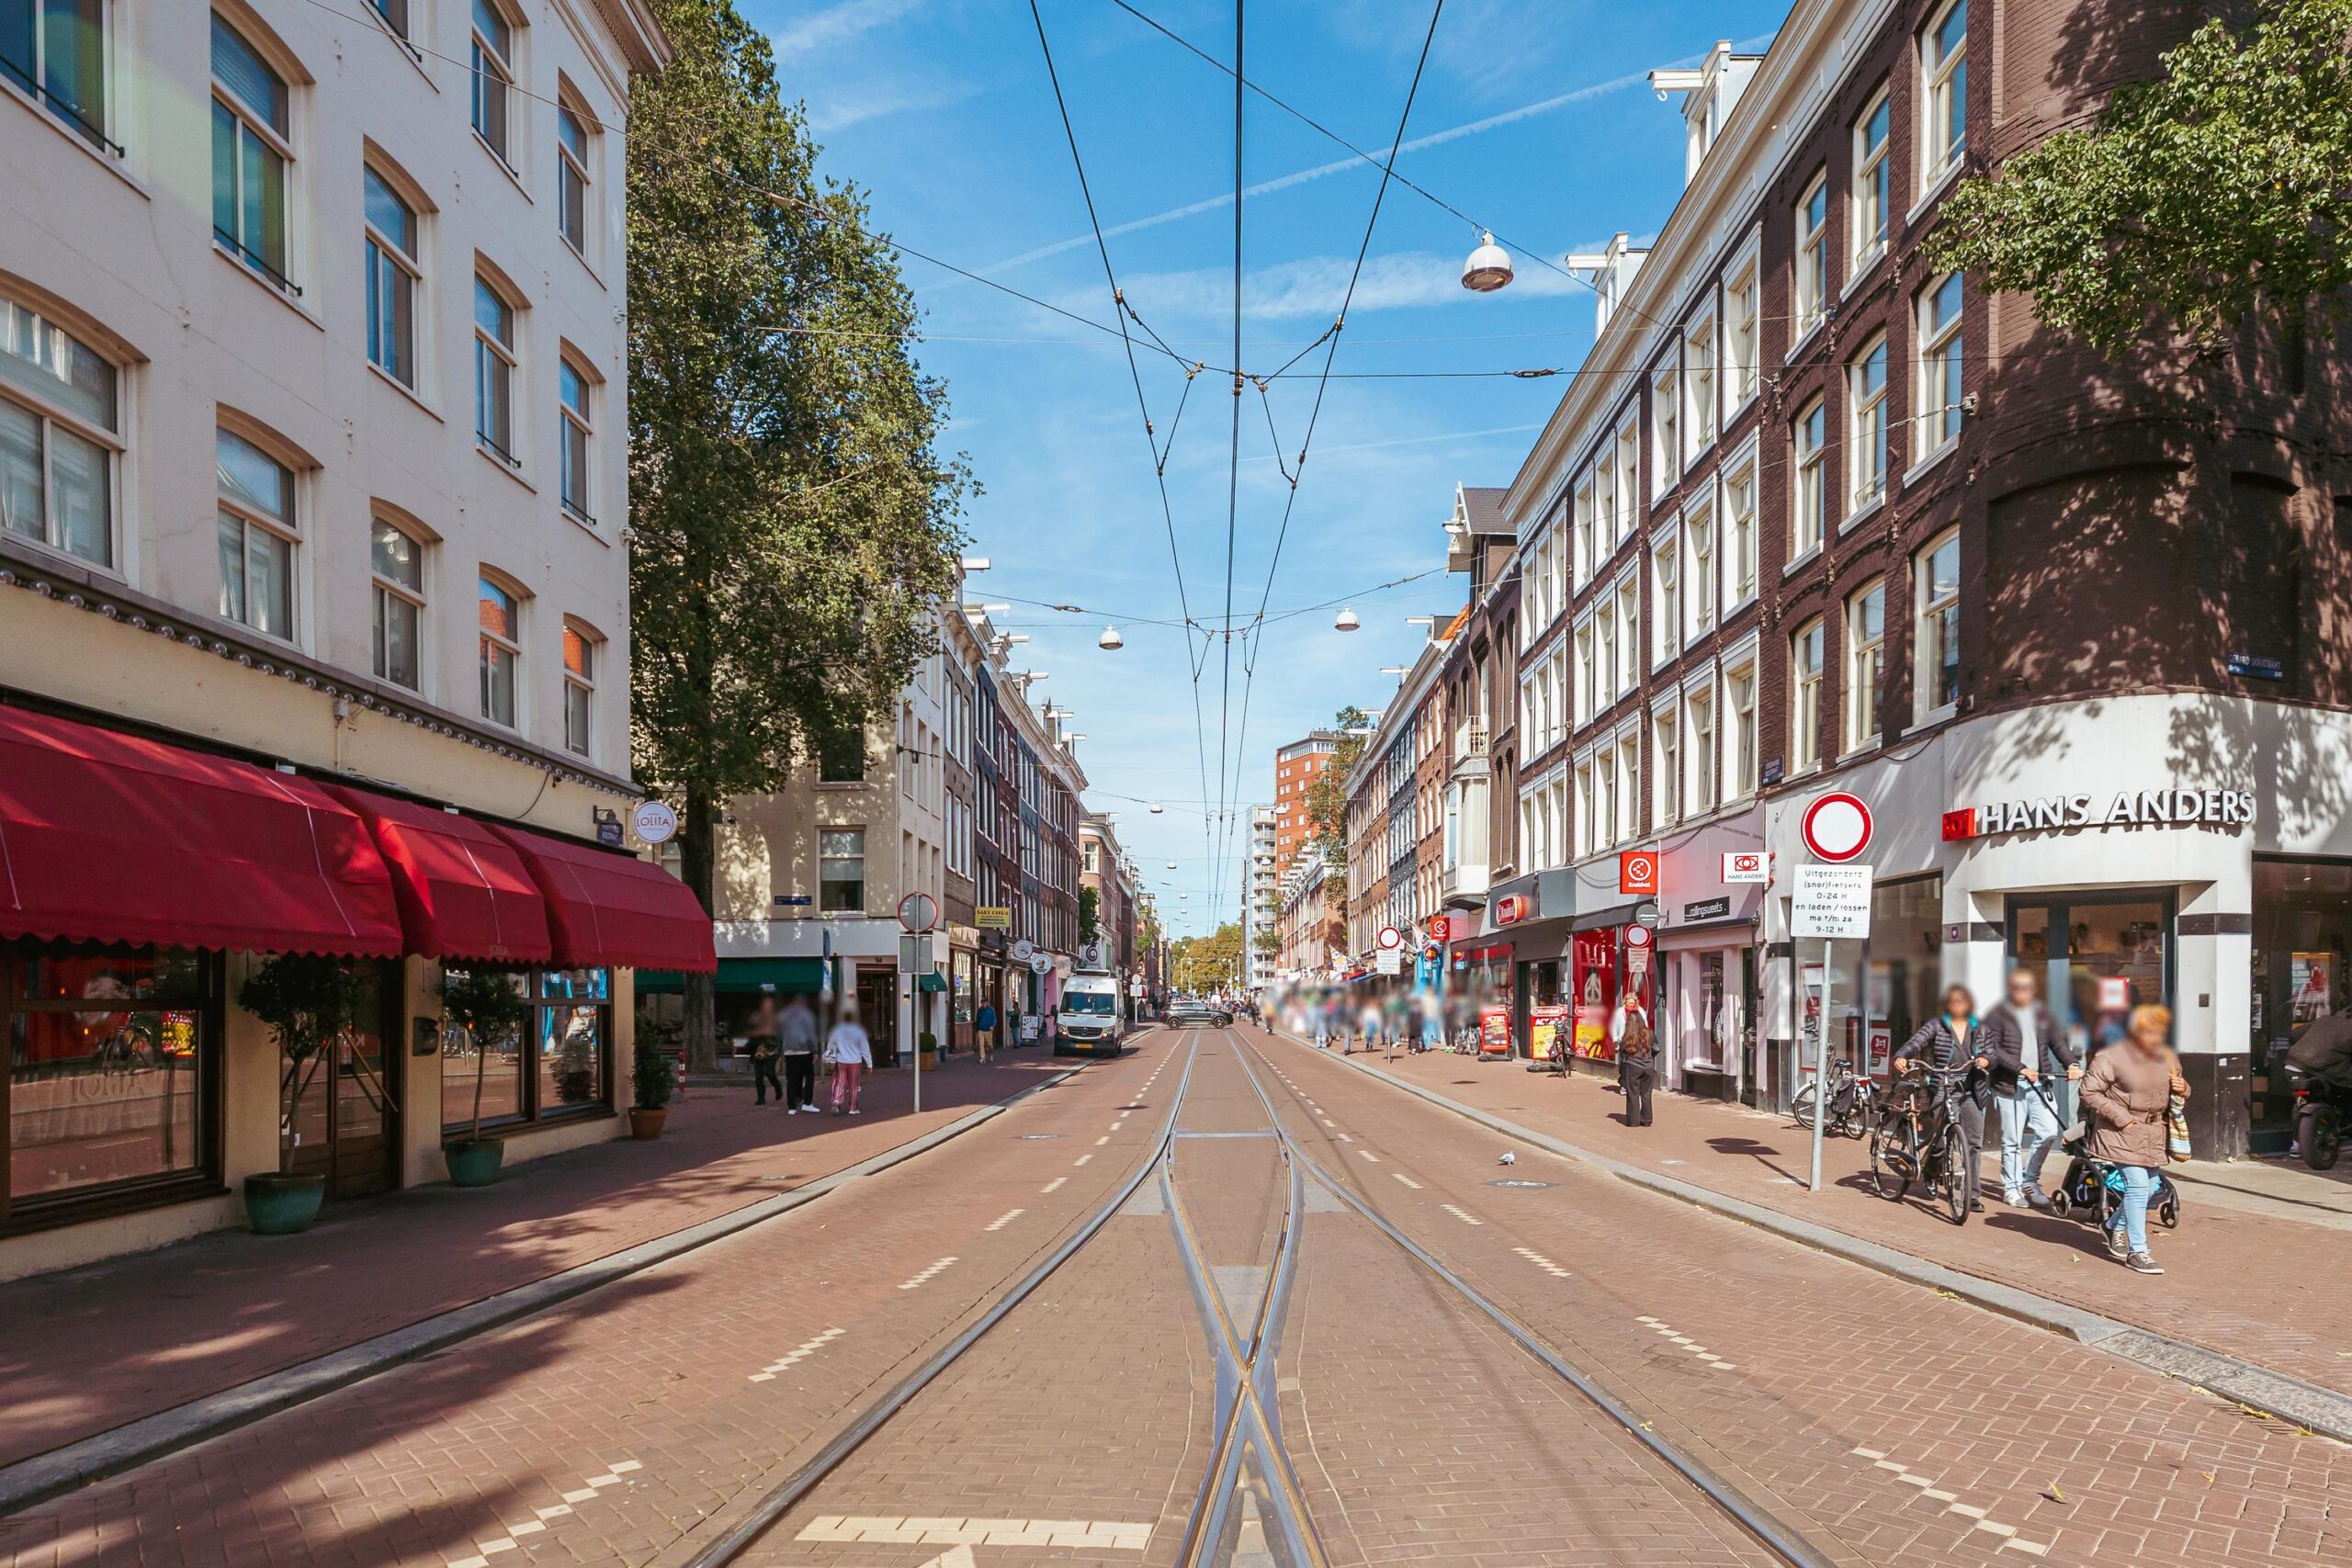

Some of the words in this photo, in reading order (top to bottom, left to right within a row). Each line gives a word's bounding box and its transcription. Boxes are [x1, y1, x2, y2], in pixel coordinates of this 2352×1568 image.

[637, 817, 671, 828] LOLITA
[1981, 794, 2092, 834] HANS
[2105, 789, 2254, 824] ANDERS
